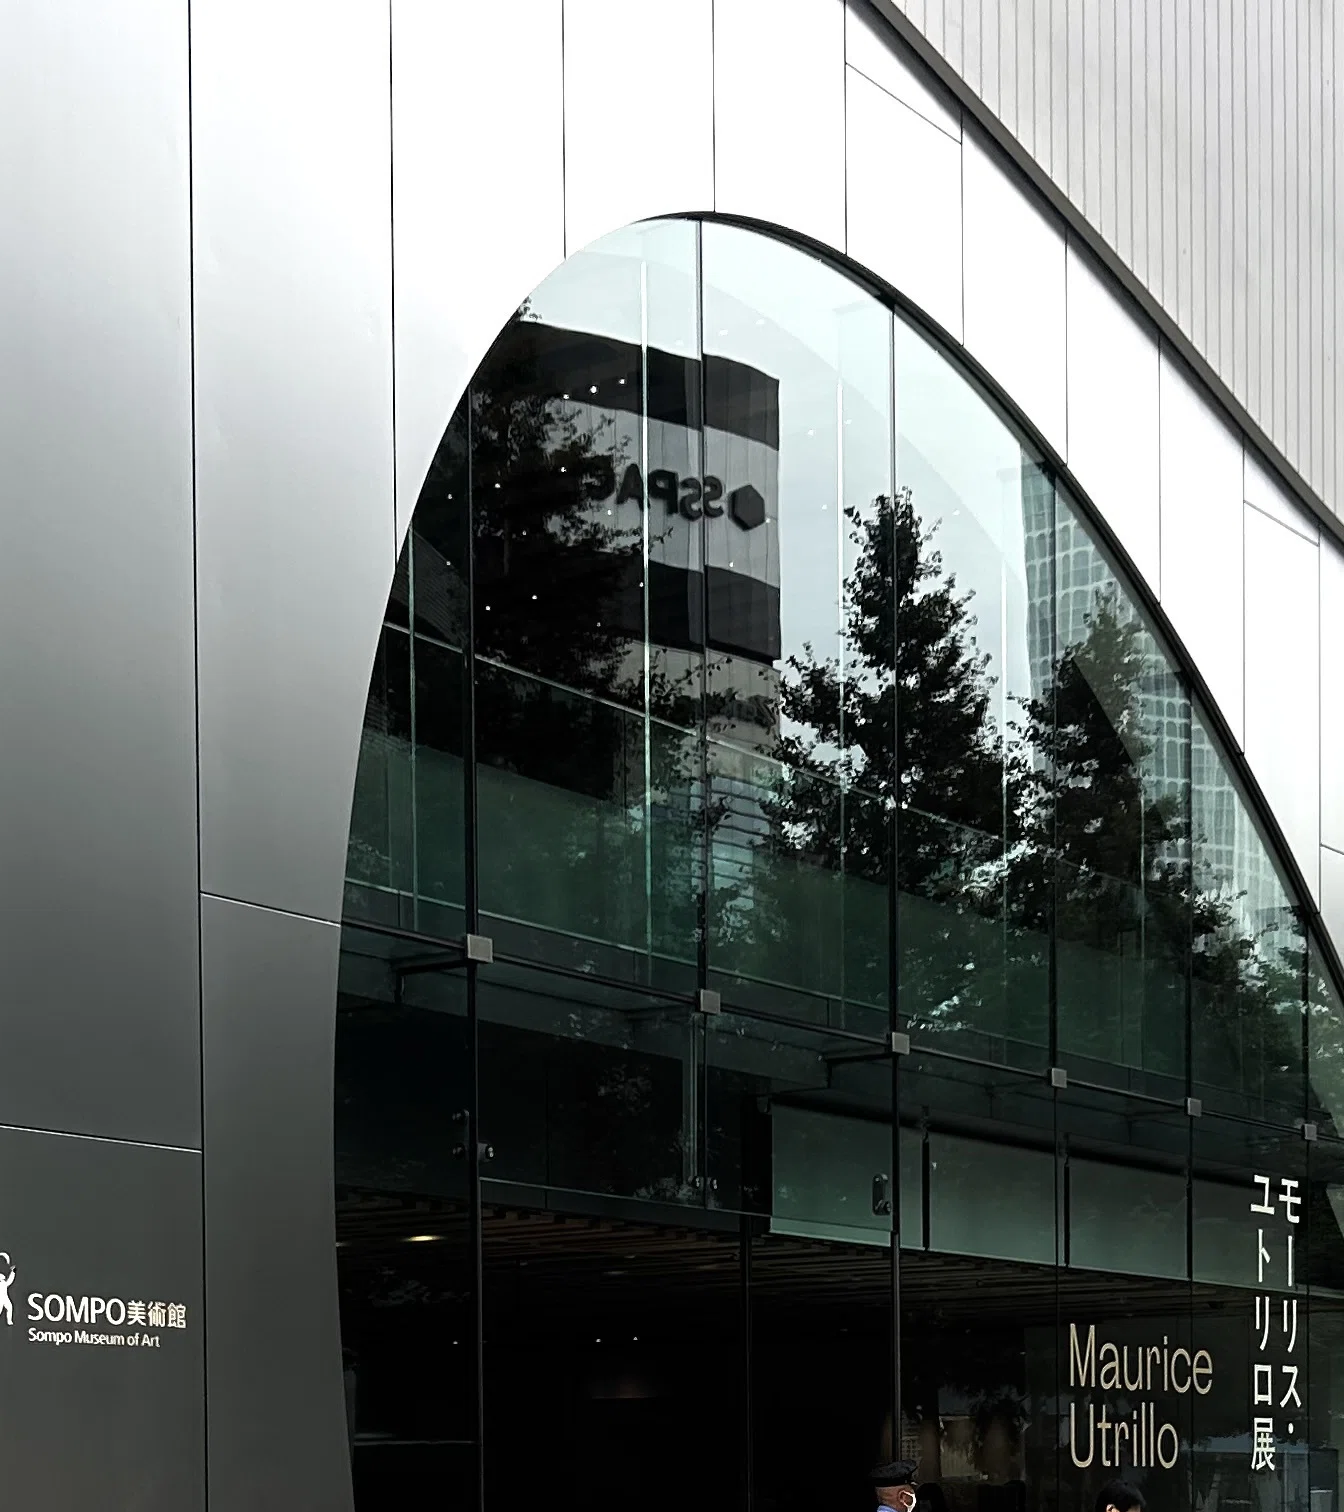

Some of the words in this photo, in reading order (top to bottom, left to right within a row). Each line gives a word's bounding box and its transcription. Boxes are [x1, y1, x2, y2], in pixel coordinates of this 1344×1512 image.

[27, 1292, 187, 1329] SOMPO美術館
[28, 1327, 73, 1346] Sompo
[74, 1330, 125, 1346] Museum
[127, 1332, 140, 1346] of
[141, 1333, 161, 1348] Art
[1250, 1174, 1276, 1471] ユトリロ展
[1278, 1178, 1302, 1434] モーリス・
[1069, 1323, 1213, 1395] Maurice
[1069, 1402, 1179, 1469] Utrillo
